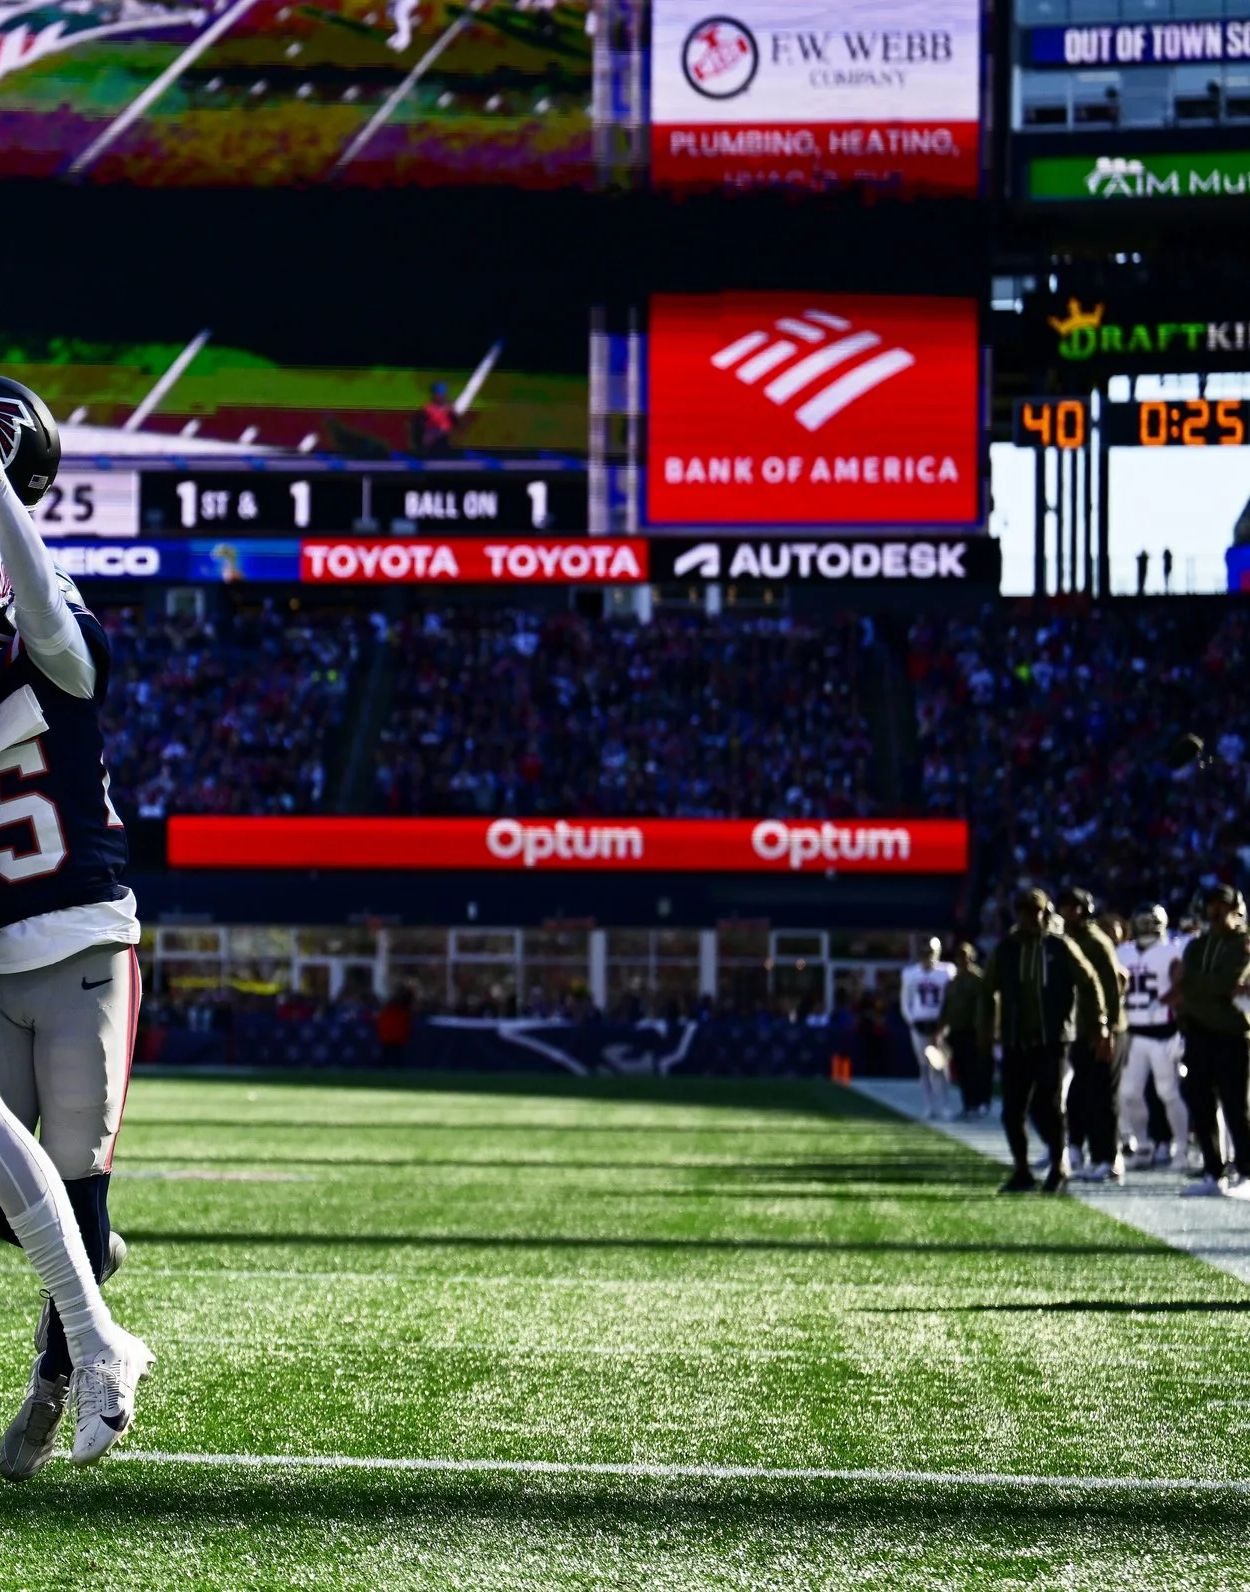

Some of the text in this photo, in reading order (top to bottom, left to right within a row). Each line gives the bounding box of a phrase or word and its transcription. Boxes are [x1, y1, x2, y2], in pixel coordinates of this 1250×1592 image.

[844, 31, 953, 63] WEBB
[1064, 28, 1113, 64] OUT
[1116, 26, 1147, 62] OF
[1152, 22, 1223, 60] TOWN
[808, 69, 908, 89] COMPANY
[669, 128, 960, 158] PLUMBING, HEATING,
[1189, 168, 1250, 196] Mu
[1058, 321, 1250, 360] DRAFTKI
[1023, 398, 1244, 449] 40 0:25
[664, 456, 959, 484] BANK OF AMERICA
[41, 485, 95, 523] 25
[238, 491, 258, 520] &
[290, 480, 310, 528] 1
[404, 490, 459, 519] BALL
[463, 490, 498, 519] ON
[527, 480, 548, 528] 1
[304, 544, 641, 579] TOYOTA TOYOTA
[729, 544, 966, 580] AUTODESK
[485, 818, 909, 868] Optum Optum
